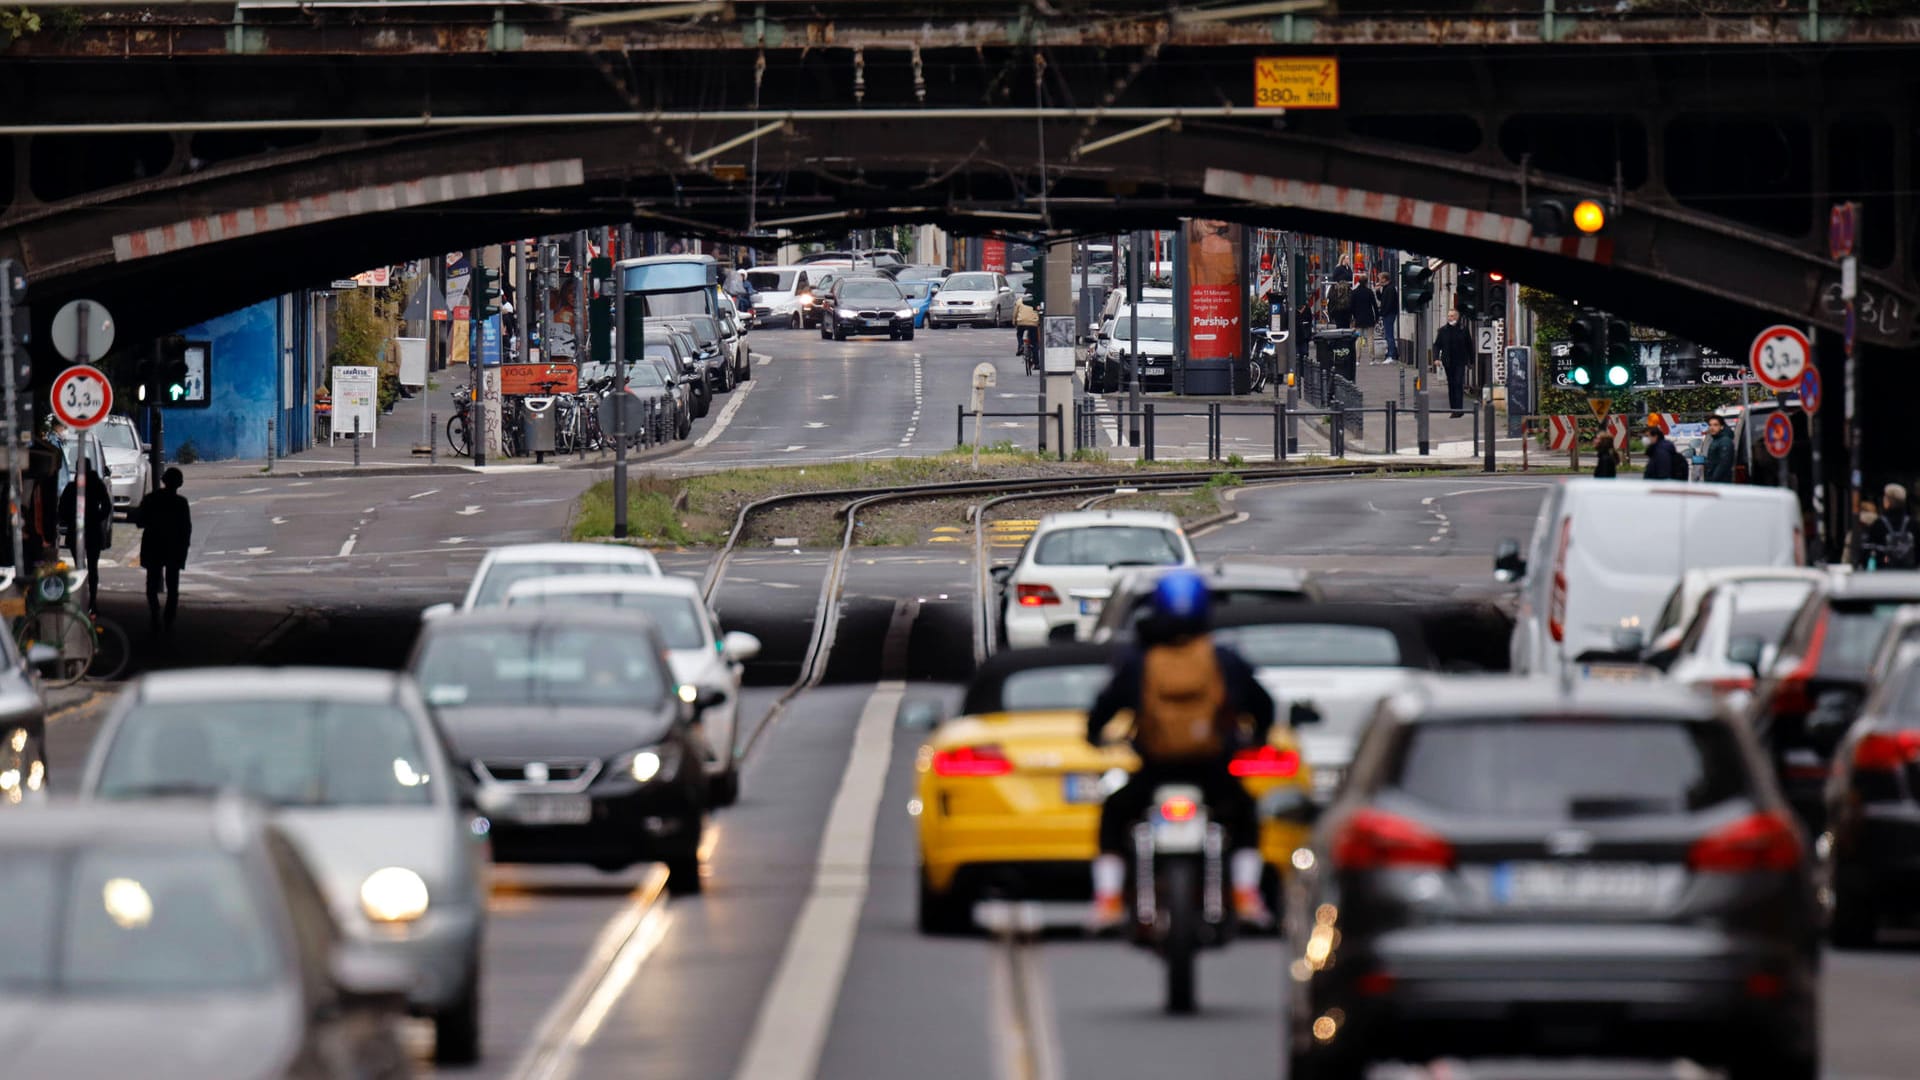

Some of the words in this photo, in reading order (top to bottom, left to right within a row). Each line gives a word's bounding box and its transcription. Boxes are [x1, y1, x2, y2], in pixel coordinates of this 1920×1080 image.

[1193, 316, 1230, 329] Parship
[1482, 331, 1492, 350] 2
[504, 367, 534, 377] YOGA
